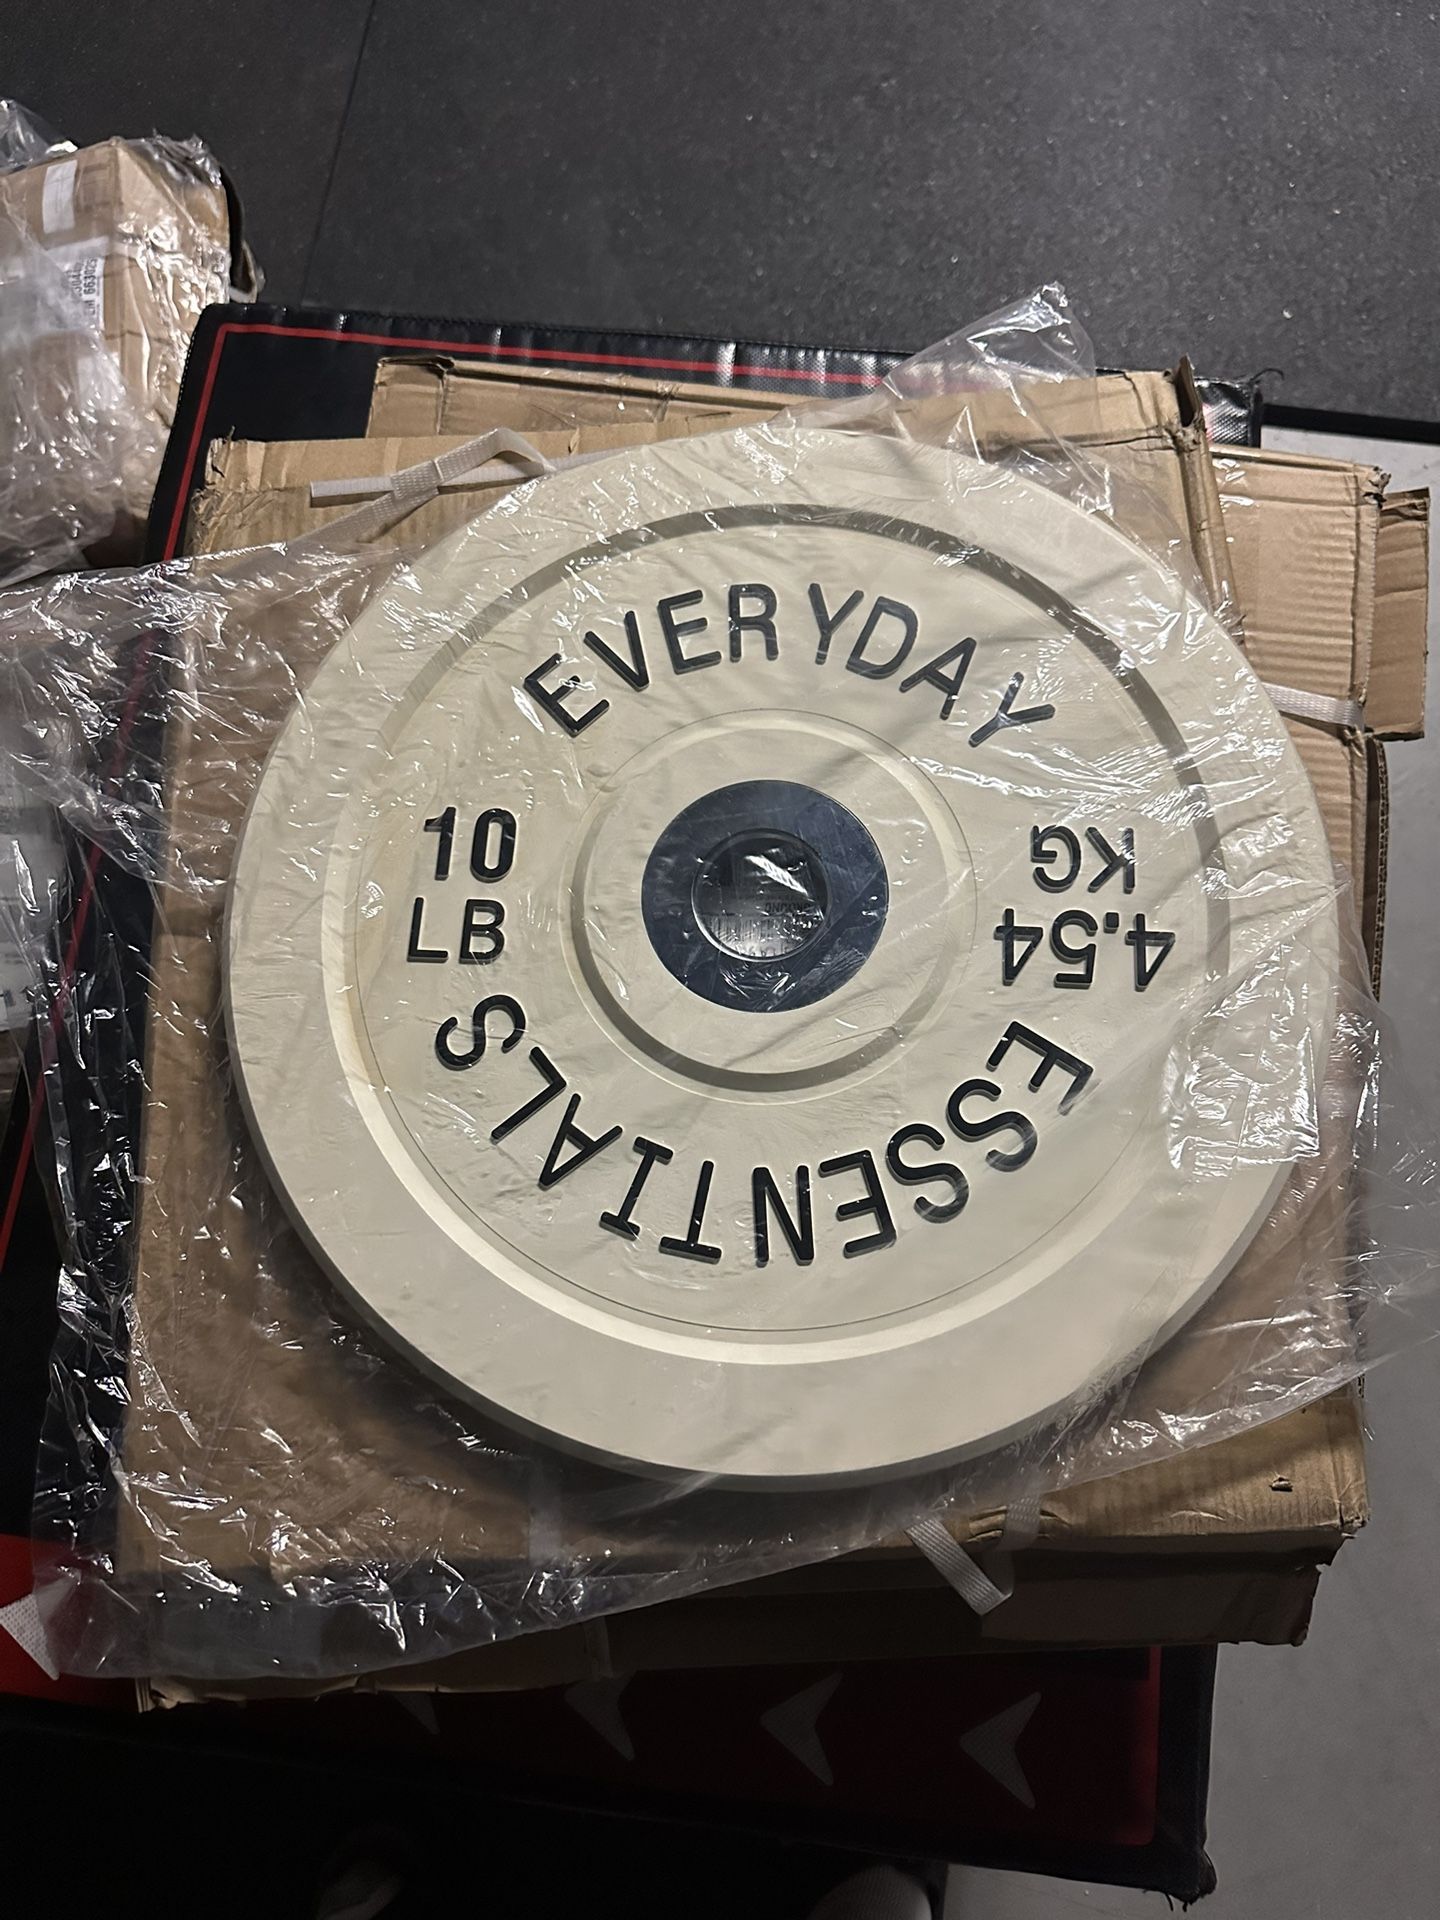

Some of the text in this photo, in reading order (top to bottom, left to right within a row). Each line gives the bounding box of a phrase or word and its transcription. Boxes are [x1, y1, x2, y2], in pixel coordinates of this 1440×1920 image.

[523, 583, 1055, 747] EVERYDAY
[424, 806, 517, 880] 10
[1029, 825, 1138, 893] KG
[407, 897, 506, 963] LB
[993, 907, 1177, 991] 4.54
[434, 993, 1093, 1266] ESSENTIALS
